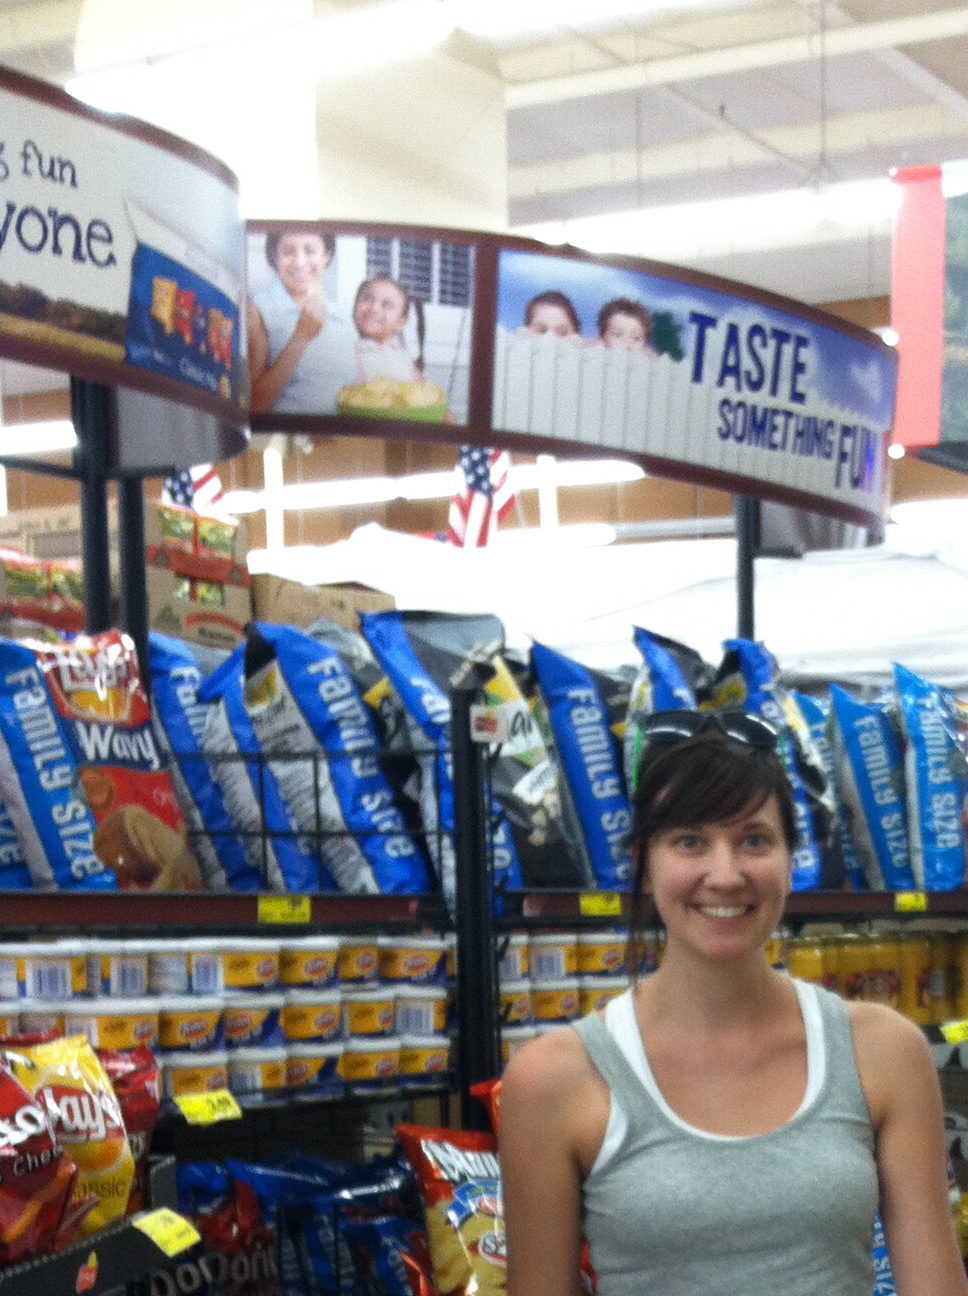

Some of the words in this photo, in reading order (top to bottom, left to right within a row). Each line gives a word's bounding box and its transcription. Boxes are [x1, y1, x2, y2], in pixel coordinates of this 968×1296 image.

[19, 139, 78, 189] fun
[689, 311, 809, 405] TASTE
[717, 398, 835, 460] SOMETHING
[75, 719, 161, 771] Wavy
